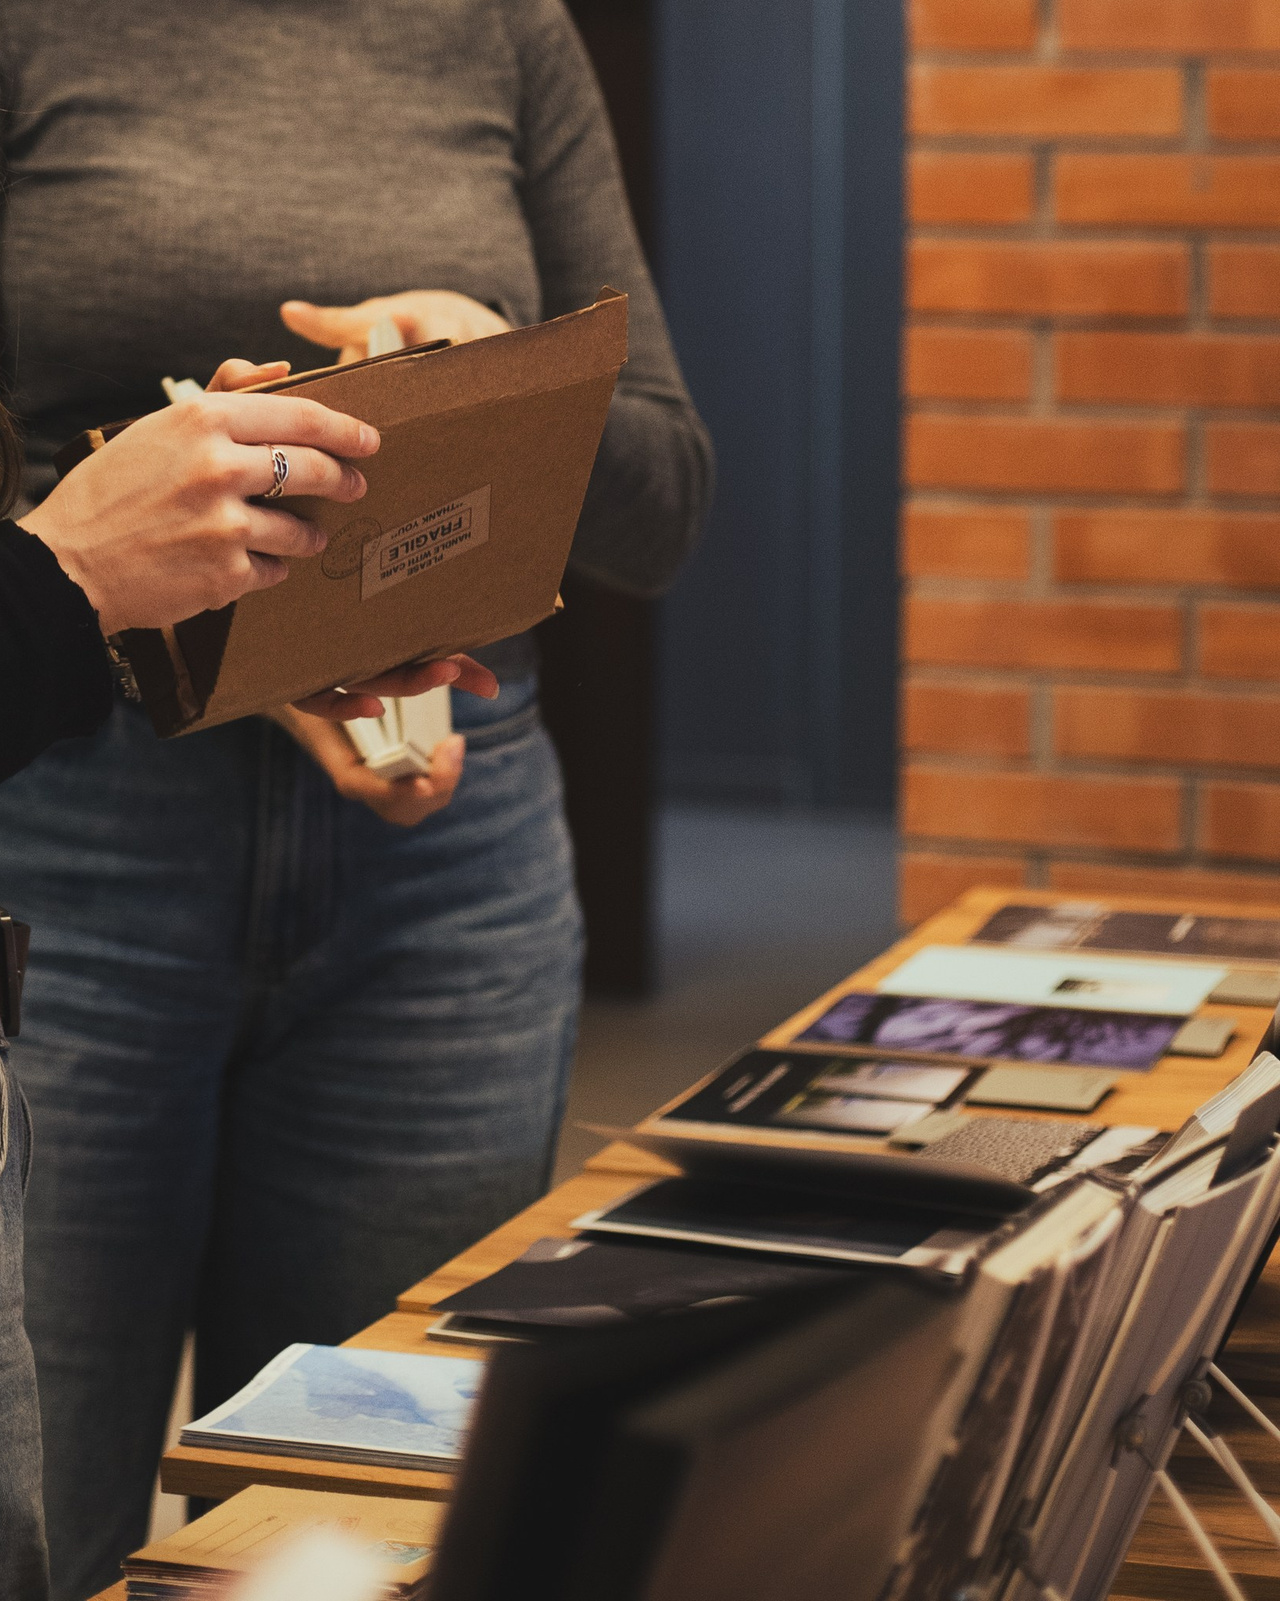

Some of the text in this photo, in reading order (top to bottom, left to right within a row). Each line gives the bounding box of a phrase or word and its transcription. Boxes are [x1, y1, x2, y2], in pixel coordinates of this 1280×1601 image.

[380, 532, 471, 579] HANDLE WITH CARE
[389, 517, 462, 561] FRAGILE
[407, 553, 443, 576] PLEASE
